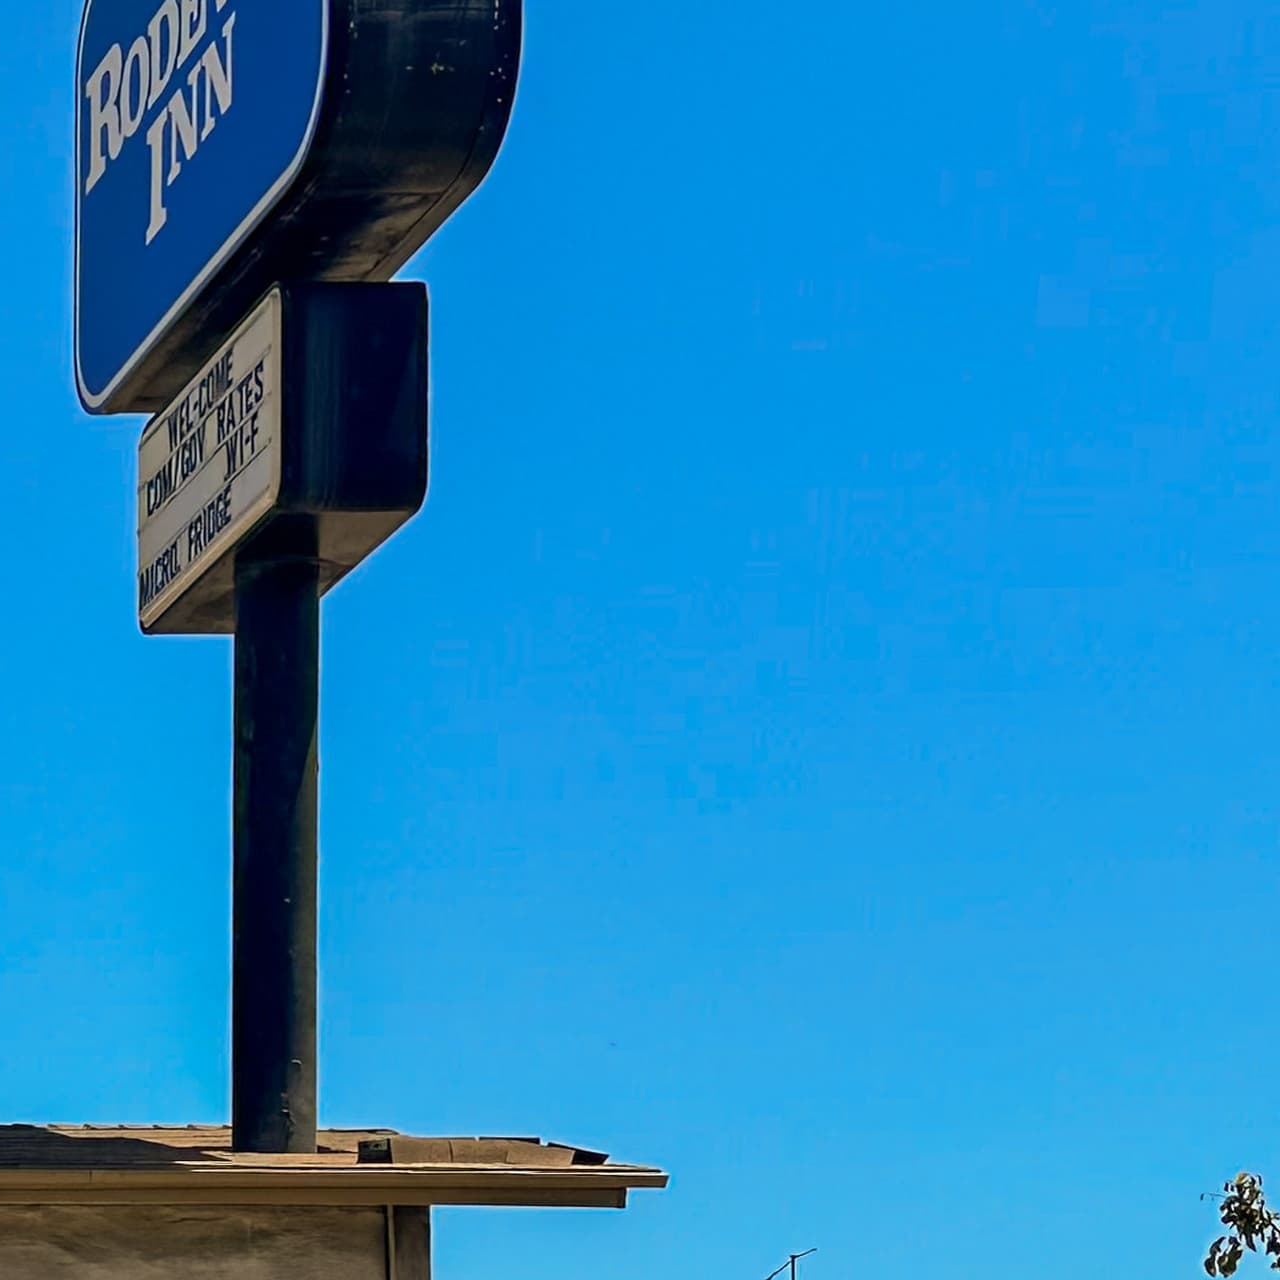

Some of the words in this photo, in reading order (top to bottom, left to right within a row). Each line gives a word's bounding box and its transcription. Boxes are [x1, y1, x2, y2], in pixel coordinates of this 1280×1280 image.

[85, 0, 227, 195] RODE
[145, 11, 236, 246] INN
[217, 360, 264, 445] RATES
[187, 484, 232, 562] FRIDGE
